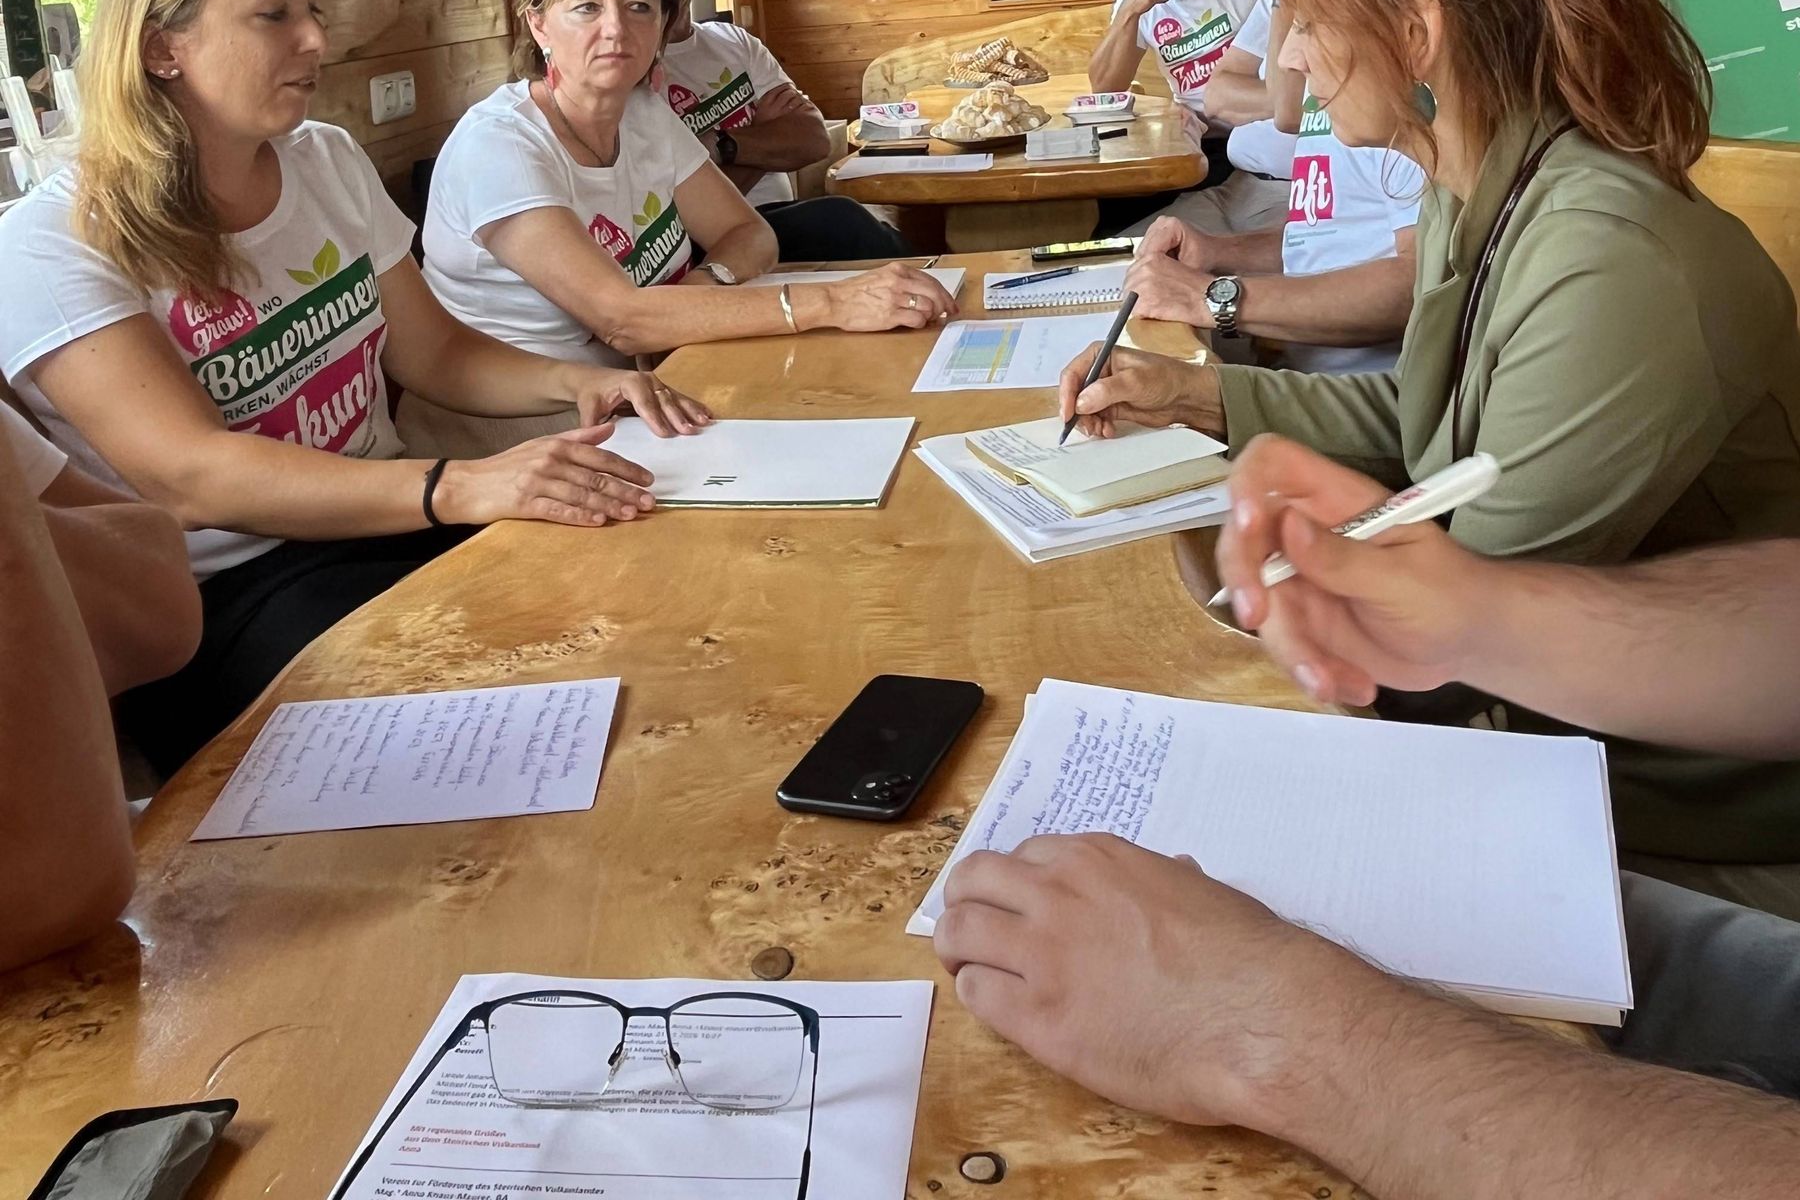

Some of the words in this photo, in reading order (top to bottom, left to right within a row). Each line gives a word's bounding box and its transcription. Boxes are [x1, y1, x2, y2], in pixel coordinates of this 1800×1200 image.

[1160, 20, 1230, 61] Bäuerinnen
[1172, 46, 1227, 93] Zuku
[682, 80, 752, 135] Bäuerinnen
[183, 300, 224, 327] let
[257, 295, 283, 315] WO
[192, 300, 253, 356] grow!
[197, 272, 379, 401] Bäuerinnen
[223, 392, 275, 422] RKEN,
[276, 349, 330, 394] WÄCHST
